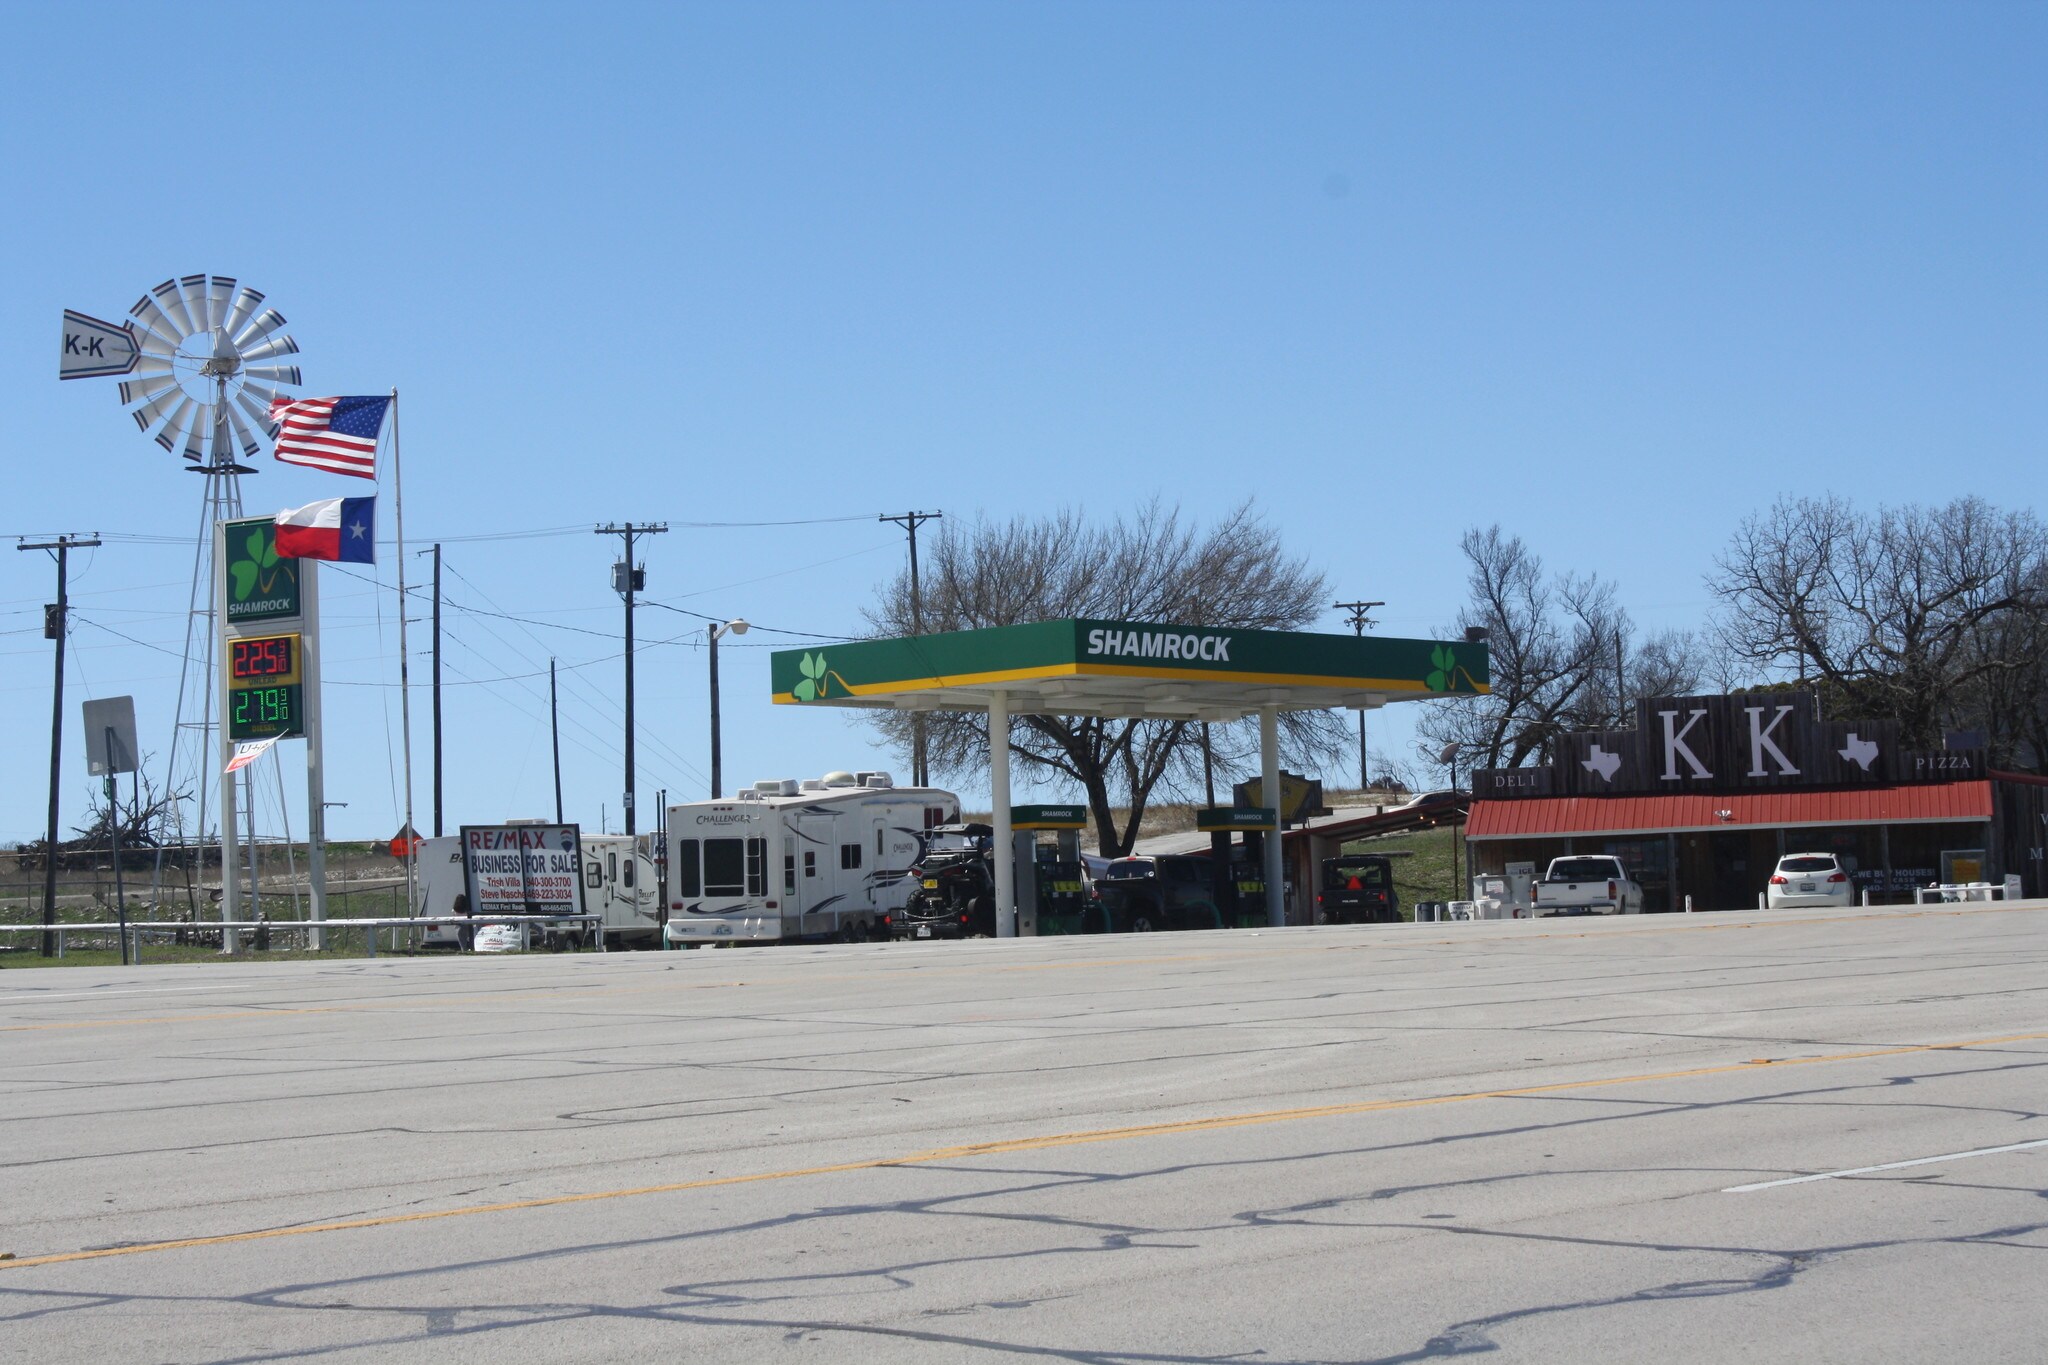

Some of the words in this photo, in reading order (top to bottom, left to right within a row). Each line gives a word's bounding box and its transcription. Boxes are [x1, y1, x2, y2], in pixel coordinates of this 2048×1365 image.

[65, 333, 104, 358] K-K
[229, 598, 290, 615] SHAMROCK
[1087, 628, 1232, 662] SHAMROCK
[236, 689, 279, 723] 2.79
[251, 724, 277, 733] DIESEL
[1658, 708, 1713, 781] K
[1743, 704, 1801, 777] K
[1915, 756, 1971, 770] PIZZA
[1495, 774, 1536, 788] DELI
[696, 814, 751, 826] CHALLENGER
[1234, 813, 1263, 821] SHAMROCK
[469, 831, 547, 850] RE/MAX
[471, 855, 521, 874] BUSINESS
[525, 855, 547, 874] FOR
[551, 854, 579, 874] SALE
[1518, 867, 1533, 875] ICE
[487, 876, 504, 888] Trish
[505, 876, 521, 888] Villa
[526, 876, 572, 888] 940-300-3700
[480, 888, 499, 900] Steve
